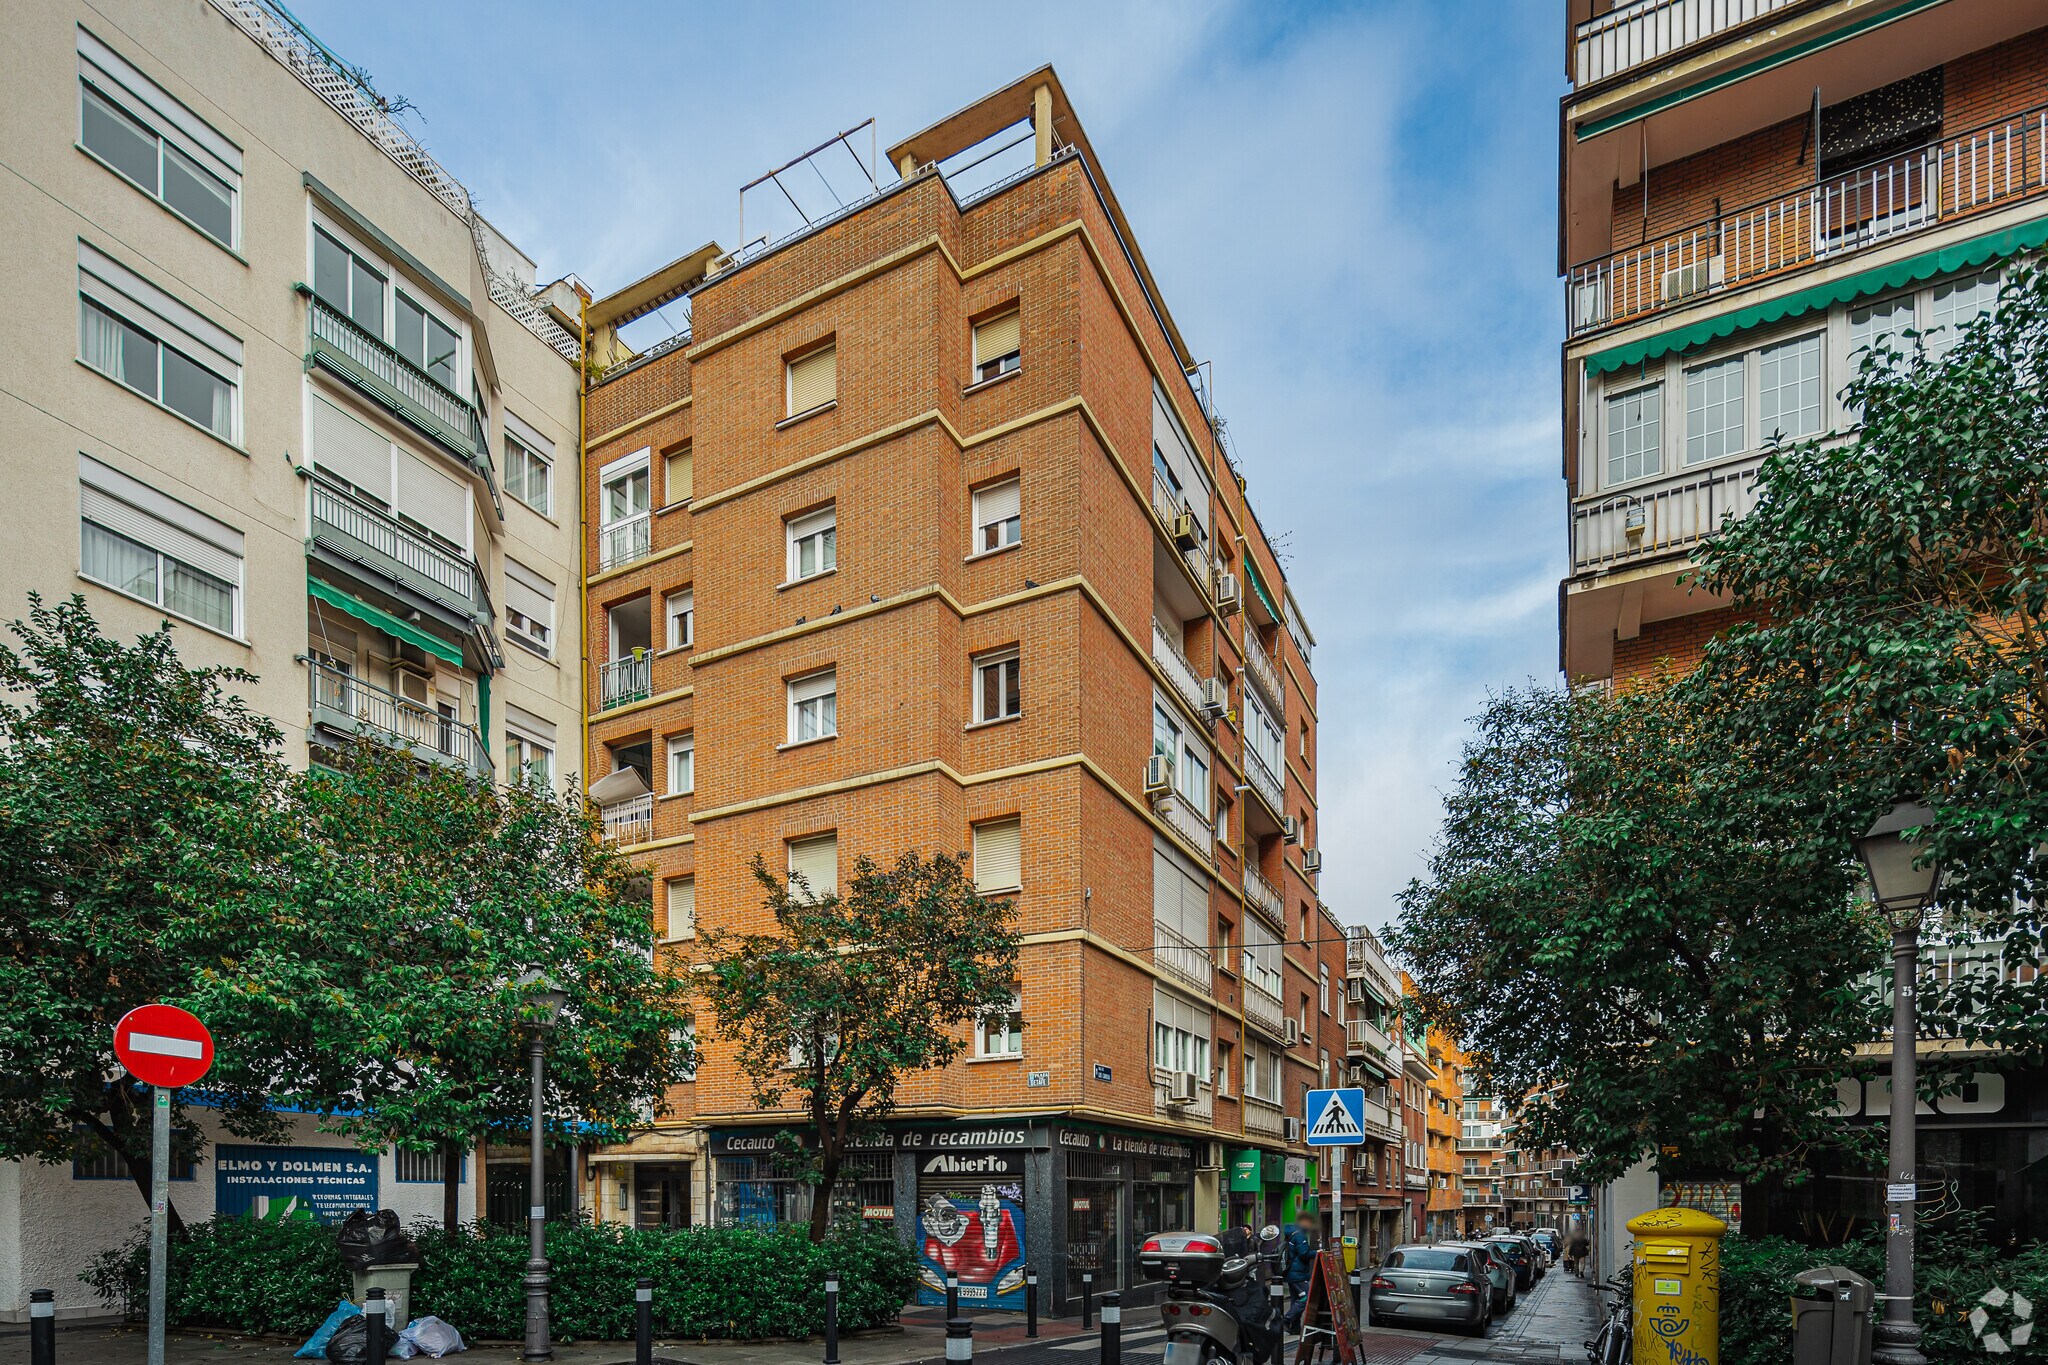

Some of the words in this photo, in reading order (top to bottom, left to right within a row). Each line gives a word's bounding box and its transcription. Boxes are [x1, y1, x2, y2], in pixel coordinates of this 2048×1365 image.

[727, 1136, 775, 1150] Cecauto
[902, 1131, 922, 1146] de
[930, 1128, 1025, 1146] recambios
[1060, 1129, 1090, 1148] Cecauto
[1112, 1136, 1122, 1152] La
[1124, 1138, 1147, 1154] tienda
[1148, 1141, 1158, 1155] de
[1160, 1144, 1191, 1159] recambios
[218, 1160, 263, 1171] ELMO
[267, 1161, 277, 1171] Y
[282, 1161, 342, 1173] DOLMEN
[346, 1163, 372, 1173] S.A.
[923, 1154, 1008, 1173] Abierto
[227, 1176, 314, 1184] INSTALACIONES
[317, 1175, 366, 1185] TÉCNICAS
[1570, 1185, 1583, 1200] P
[1073, 1200, 1090, 1209] MOTUL
[864, 1207, 895, 1217] MOTUL
